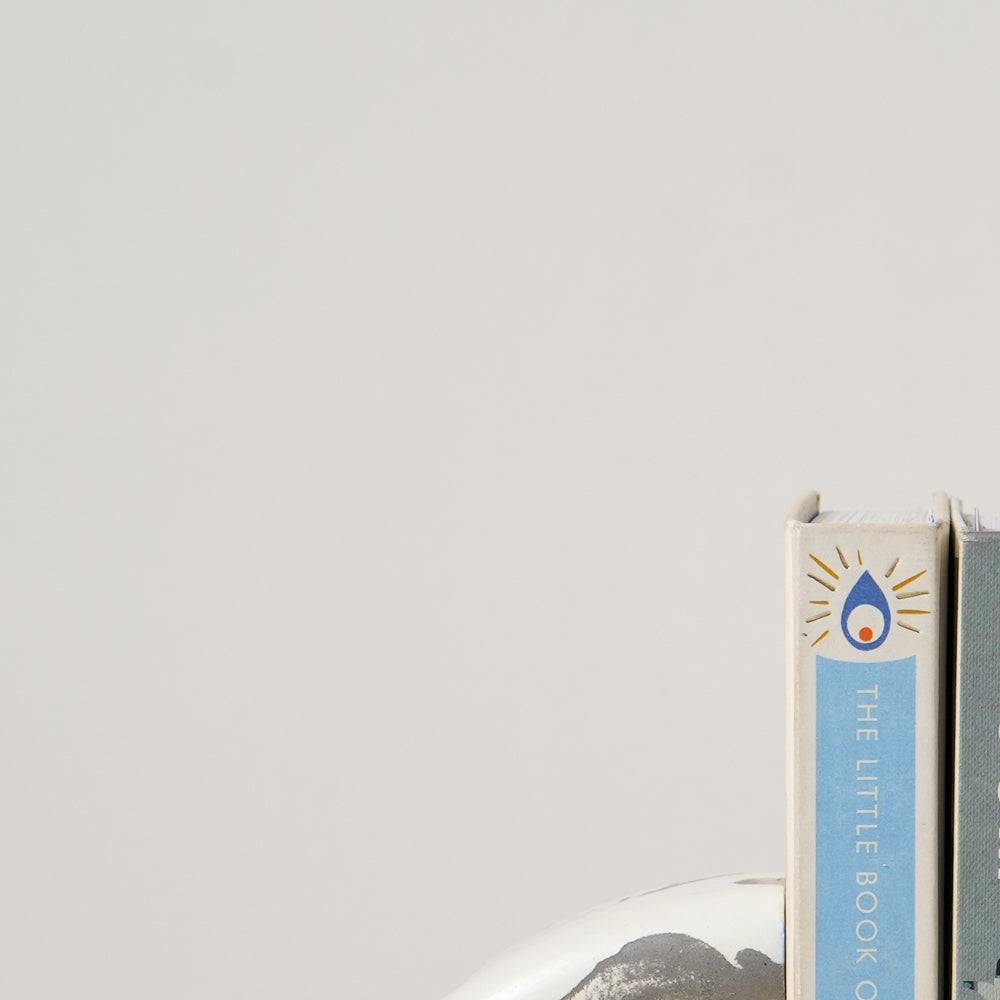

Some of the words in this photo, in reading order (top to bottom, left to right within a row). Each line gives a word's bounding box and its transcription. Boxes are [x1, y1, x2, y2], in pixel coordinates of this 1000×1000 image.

[855, 684, 879, 741] THE
[855, 759, 879, 853] LITTLE
[855, 872, 878, 963] BOOK
